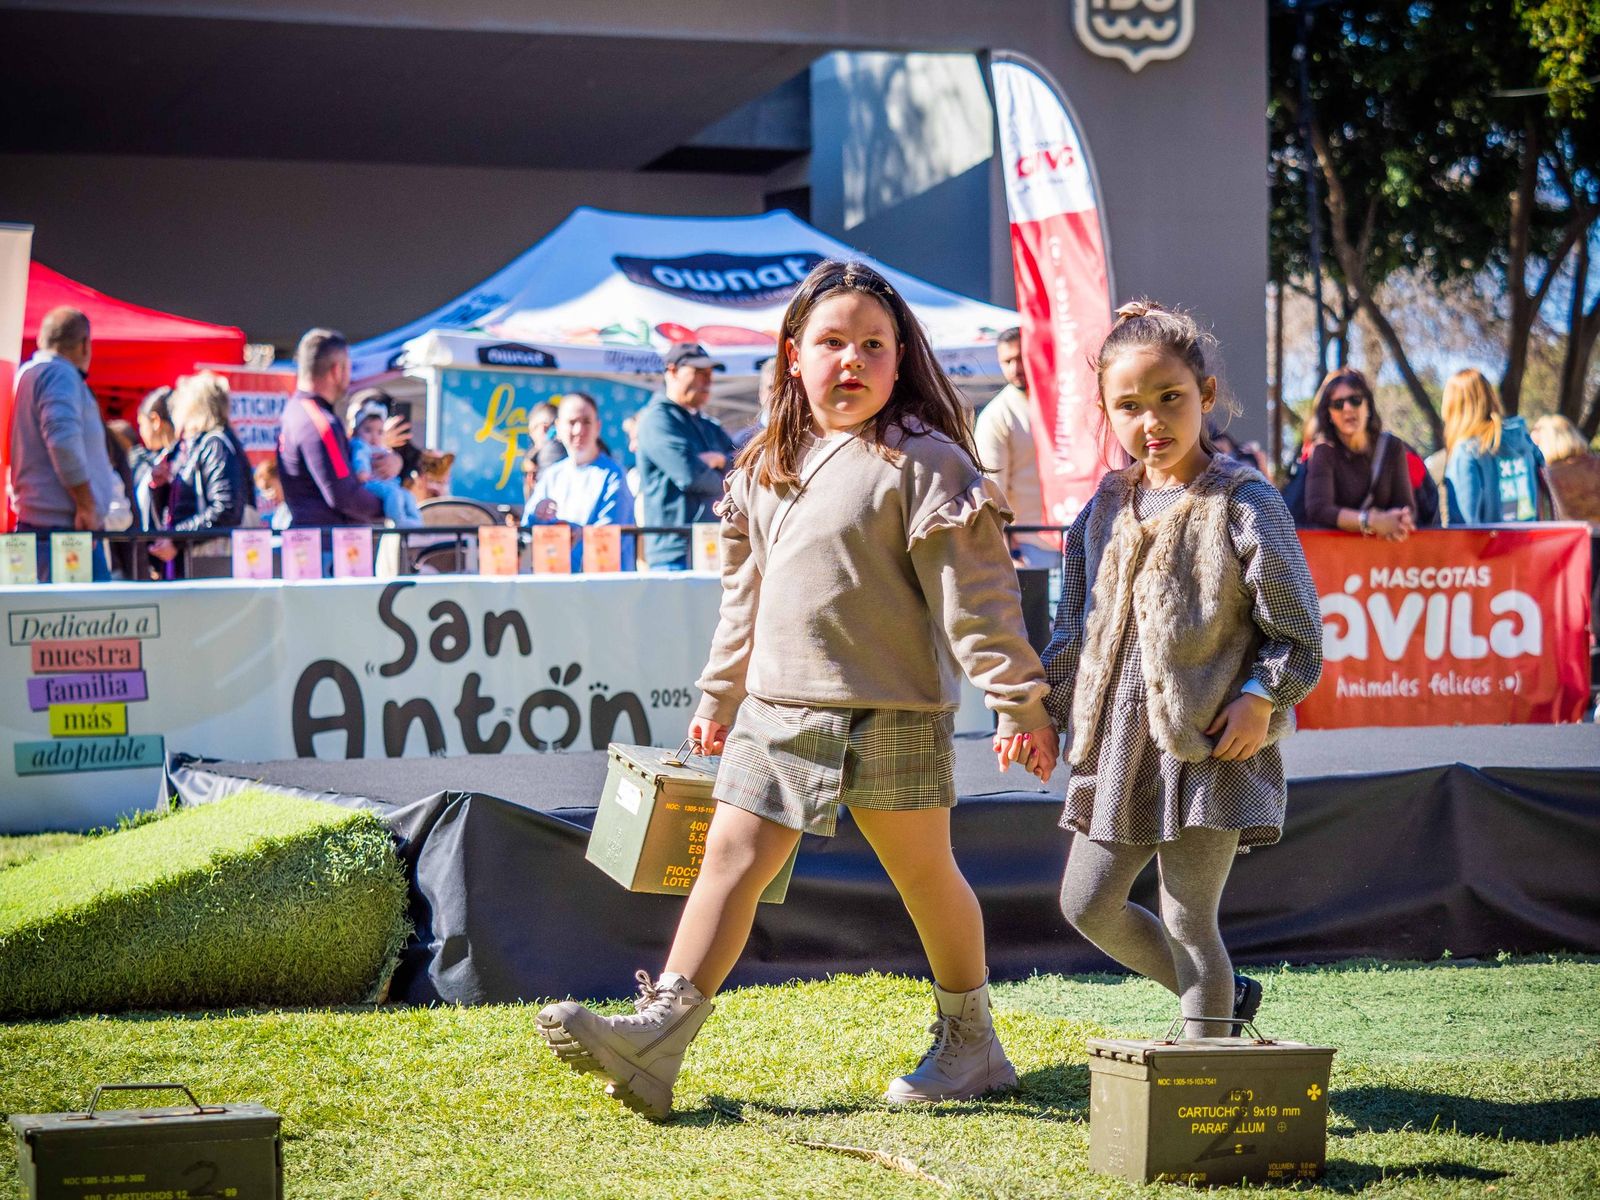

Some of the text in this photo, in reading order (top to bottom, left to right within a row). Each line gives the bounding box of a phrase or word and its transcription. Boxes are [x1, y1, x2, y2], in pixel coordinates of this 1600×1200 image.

[652, 256, 809, 292] ownat
[1370, 566, 1492, 589] MASCOTAS
[20, 612, 150, 641] Dedicado a
[378, 581, 532, 678] San
[39, 645, 132, 667] nuestra
[44, 672, 129, 703] familia
[1336, 671, 1419, 698] Animales
[1428, 671, 1491, 697] felices
[63, 704, 113, 730] más
[292, 659, 693, 760] Antón 2025
[31, 737, 146, 771] adoptable
[689, 821, 709, 832] 400
[662, 876, 691, 888] LOTE
[1253, 1105, 1278, 1118] 9x19
[1282, 1107, 1301, 1117] mm
[1191, 1121, 1266, 1135] PARABLLUM
[106, 1190, 174, 1200] CARTUCHOS
